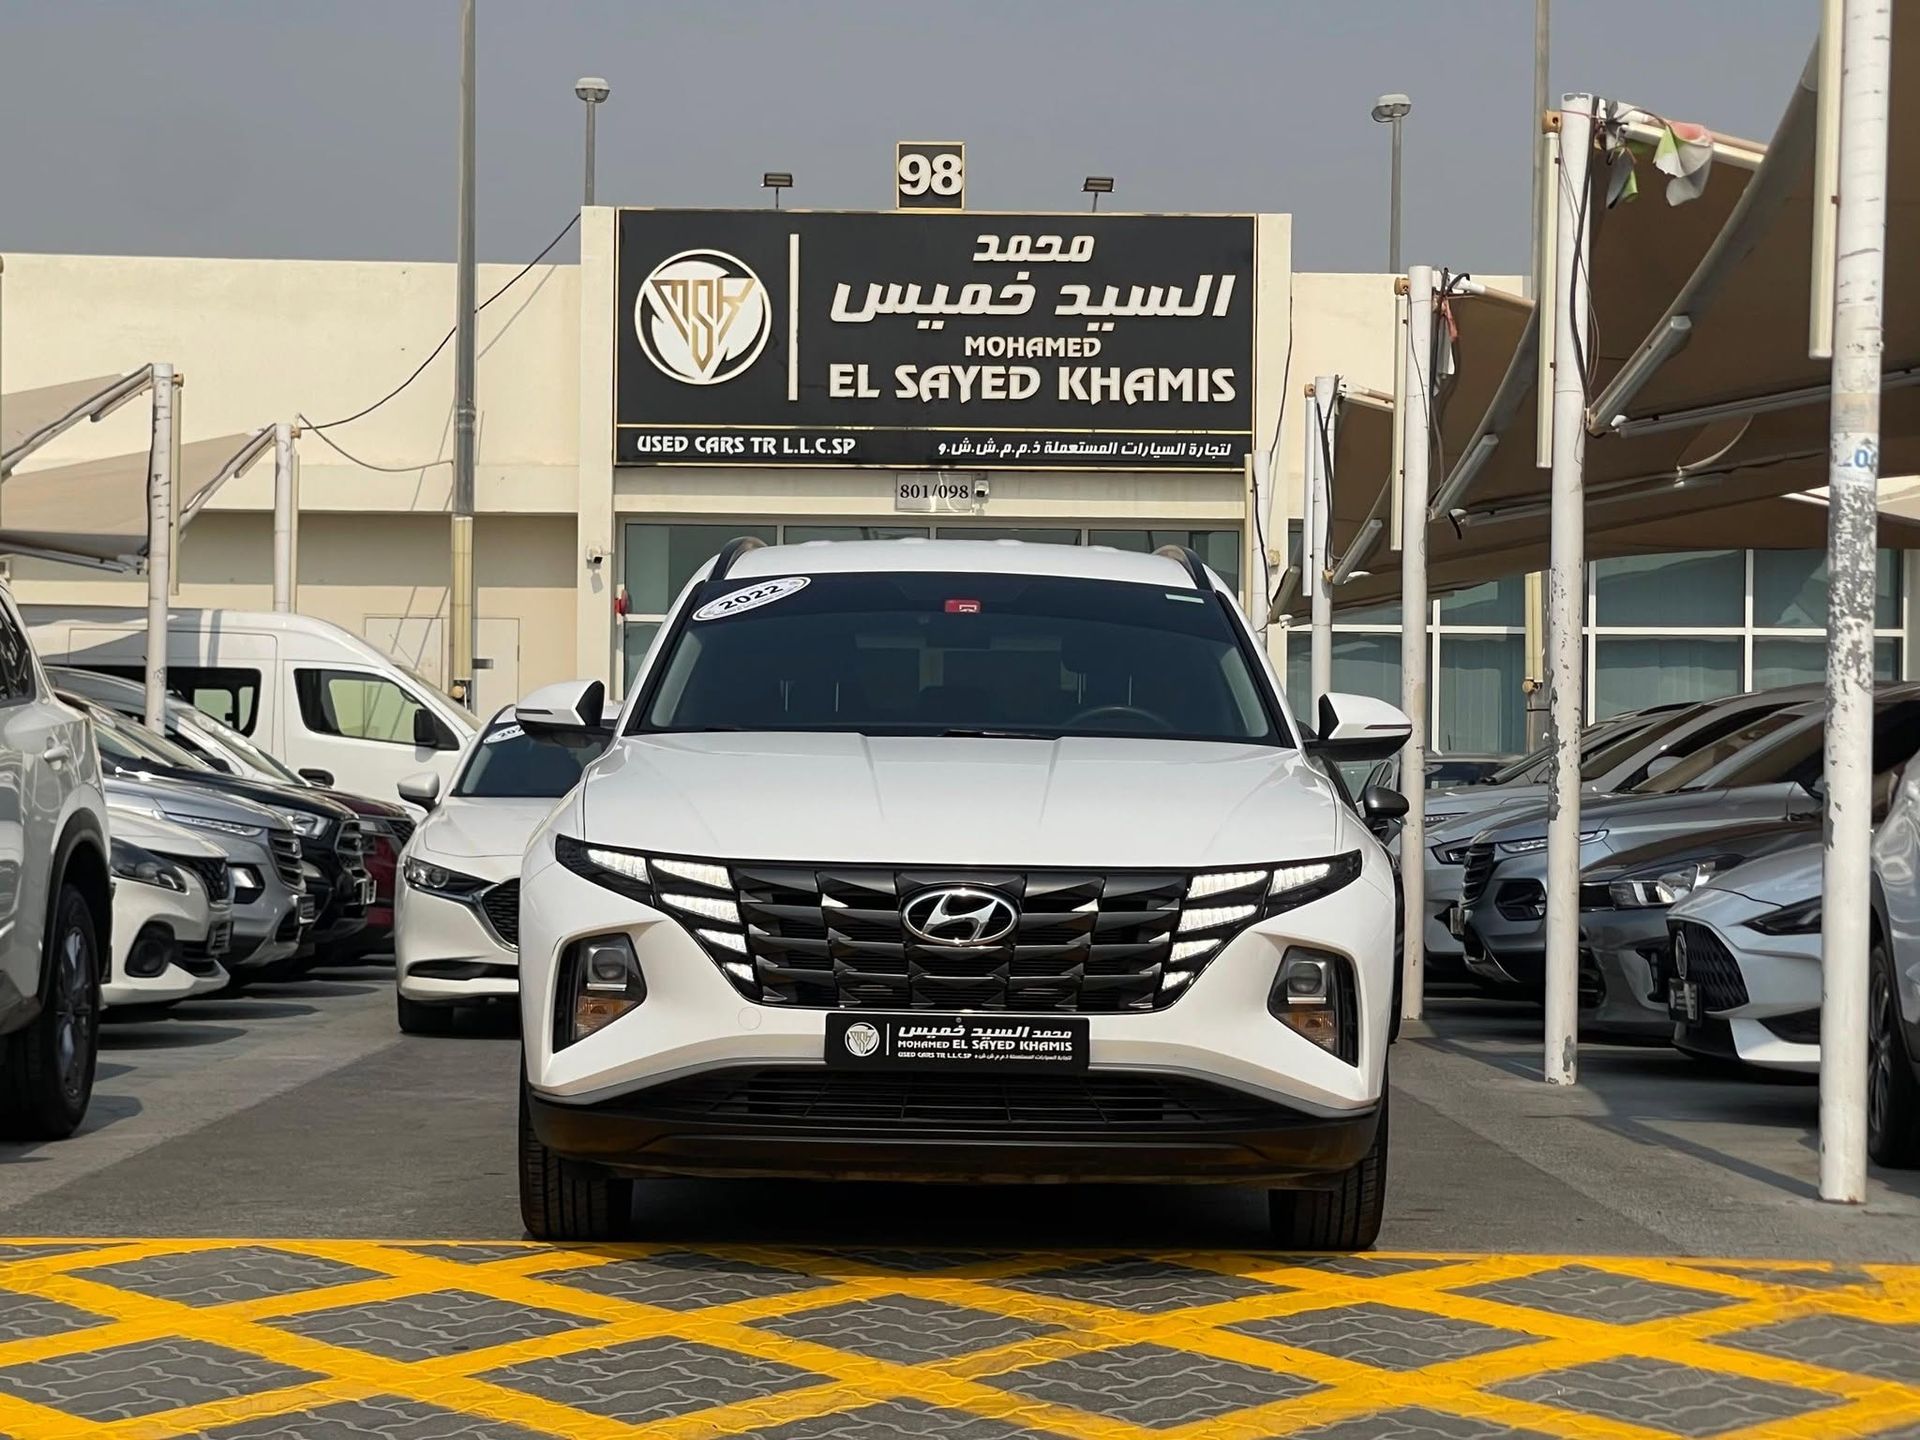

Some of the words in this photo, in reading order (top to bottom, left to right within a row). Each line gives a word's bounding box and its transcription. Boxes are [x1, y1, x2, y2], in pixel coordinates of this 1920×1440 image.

[898, 153, 963, 196] 98
[972, 234, 1095, 262] محمد
[829, 271, 1037, 331] خميس
[1054, 274, 1236, 332] السيد
[964, 335, 1102, 359] MOHAMED
[828, 363, 881, 398] EL
[894, 364, 1041, 404] SAYED
[1057, 366, 1236, 405] KHAMIS
[637, 435, 689, 453] USED
[694, 436, 745, 454] CARS
[750, 437, 777, 455] TR
[783, 437, 856, 455] L.L.C.SP
[1043, 440, 1119, 455] المستعملة
[1120, 442, 1186, 458] السيارات
[1188, 442, 1232, 459] لتجارة
[900, 484, 969, 498] 801/098
[718, 585, 783, 610] 2022
[898, 1025, 966, 1039] خميس
[970, 1026, 1030, 1040] السيد
[1031, 1030, 1073, 1039] محمد
[897, 1040, 950, 1049] MOHAMED
[952, 1039, 969, 1049] EL
[971, 1039, 1016, 1050] SAYED
[1019, 1040, 1073, 1052] KHAMIS
